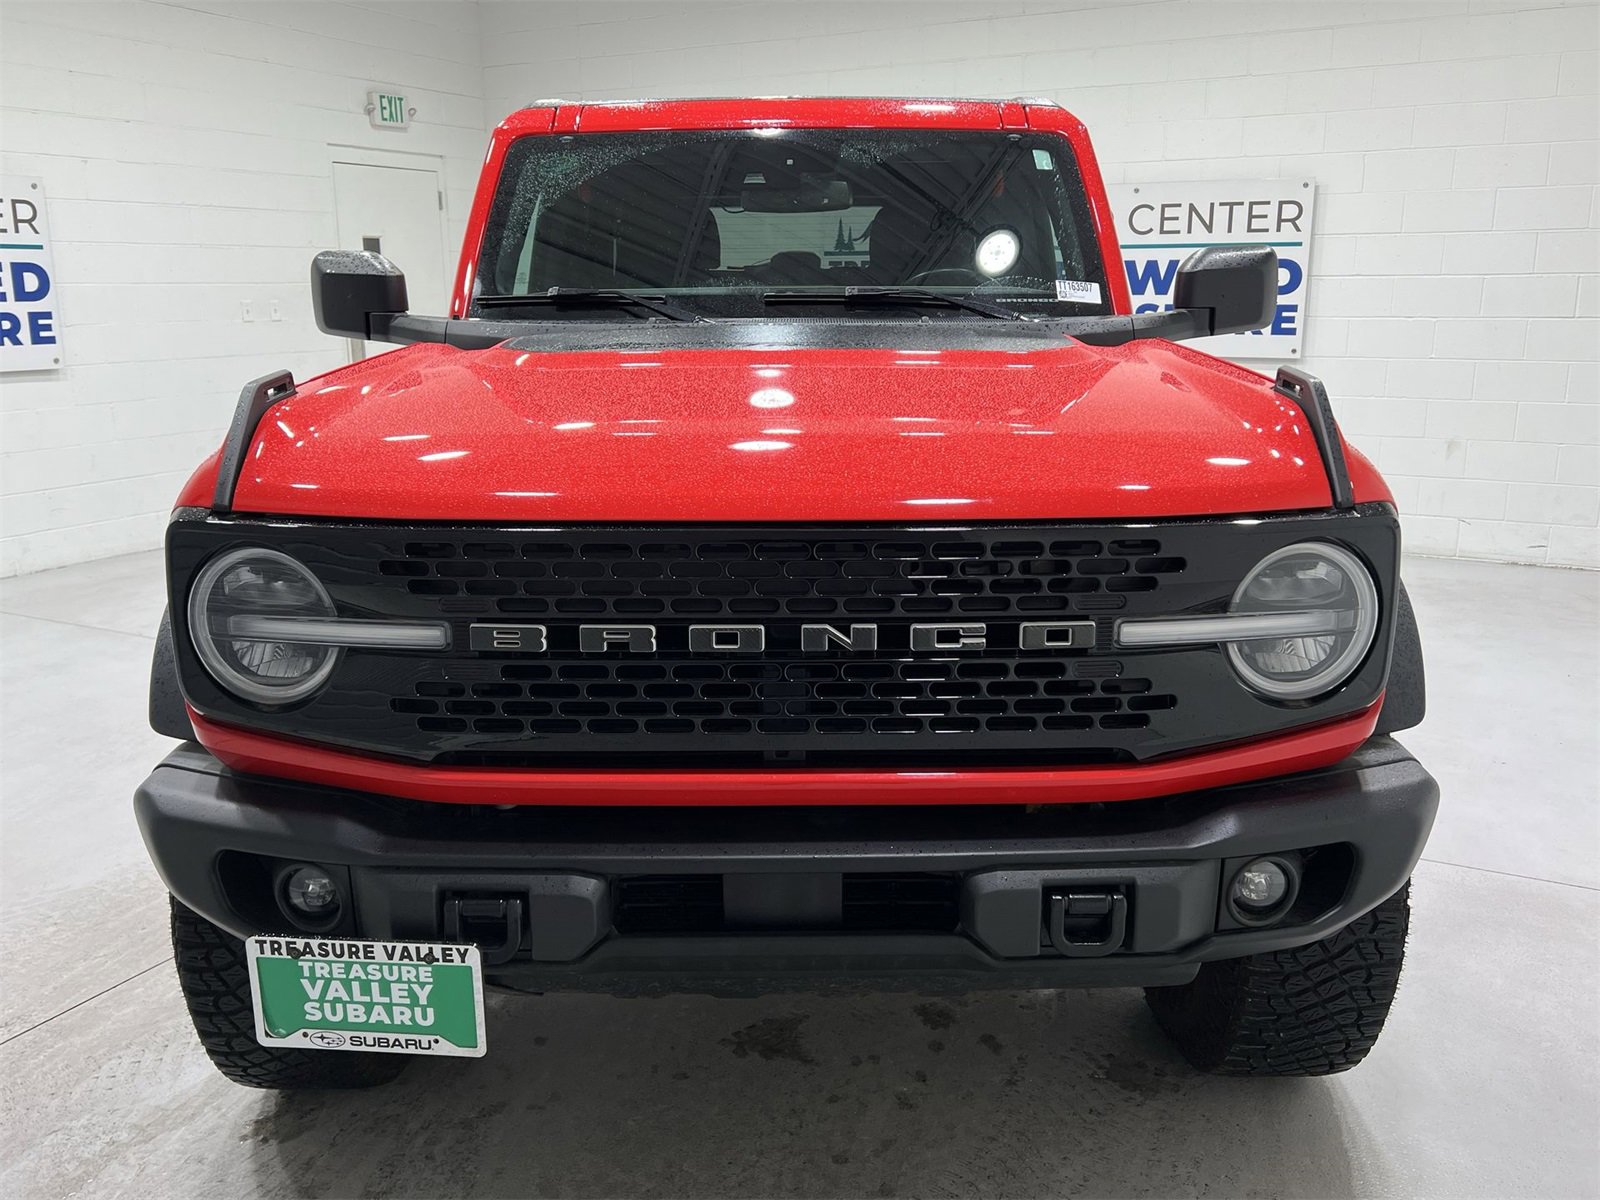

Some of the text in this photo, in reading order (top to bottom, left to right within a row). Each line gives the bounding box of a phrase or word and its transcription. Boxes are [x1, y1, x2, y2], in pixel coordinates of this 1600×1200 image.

[378, 94, 404, 124] EXIT
[1127, 199, 1304, 236] CENTER
[1057, 280, 1093, 292] TT163507
[469, 620, 1097, 654] BRONCO
[254, 939, 470, 964] TREASURE VALLEY
[298, 961, 434, 983] TREASURE
[299, 978, 434, 1006] VALLEY
[303, 1001, 436, 1027] SUBARU
[349, 1036, 434, 1051] SUBARU
